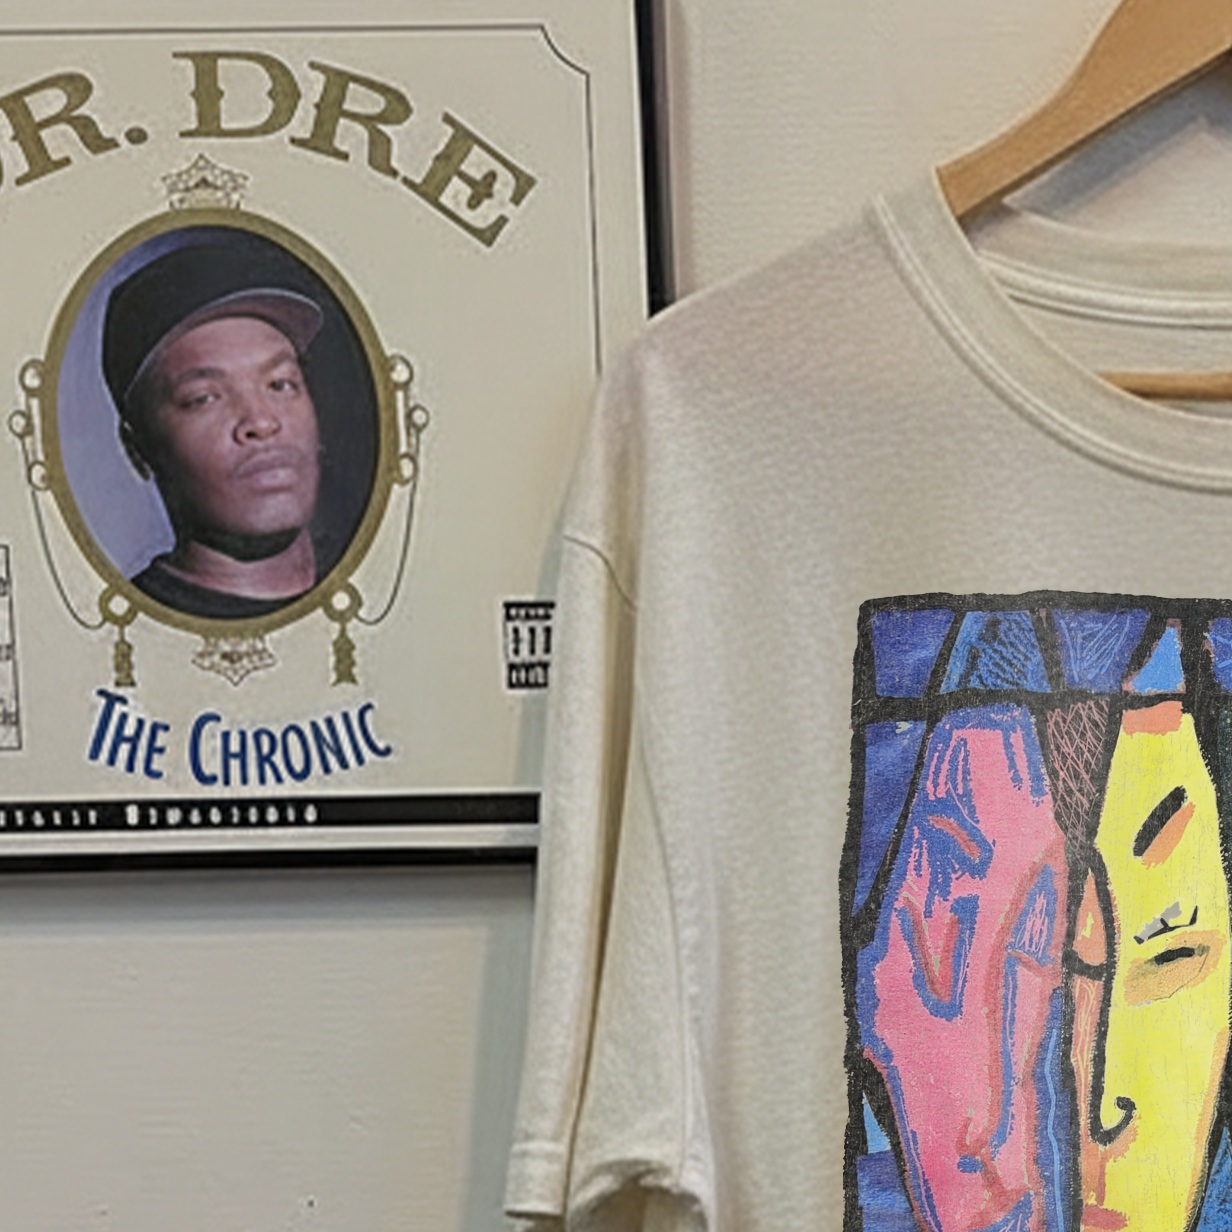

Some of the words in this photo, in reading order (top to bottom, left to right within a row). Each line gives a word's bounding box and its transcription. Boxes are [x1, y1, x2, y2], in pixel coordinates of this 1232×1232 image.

[0, 72, 148, 188] R.
[172, 51, 538, 248] DRE
[189, 702, 392, 787] CHRONIC
